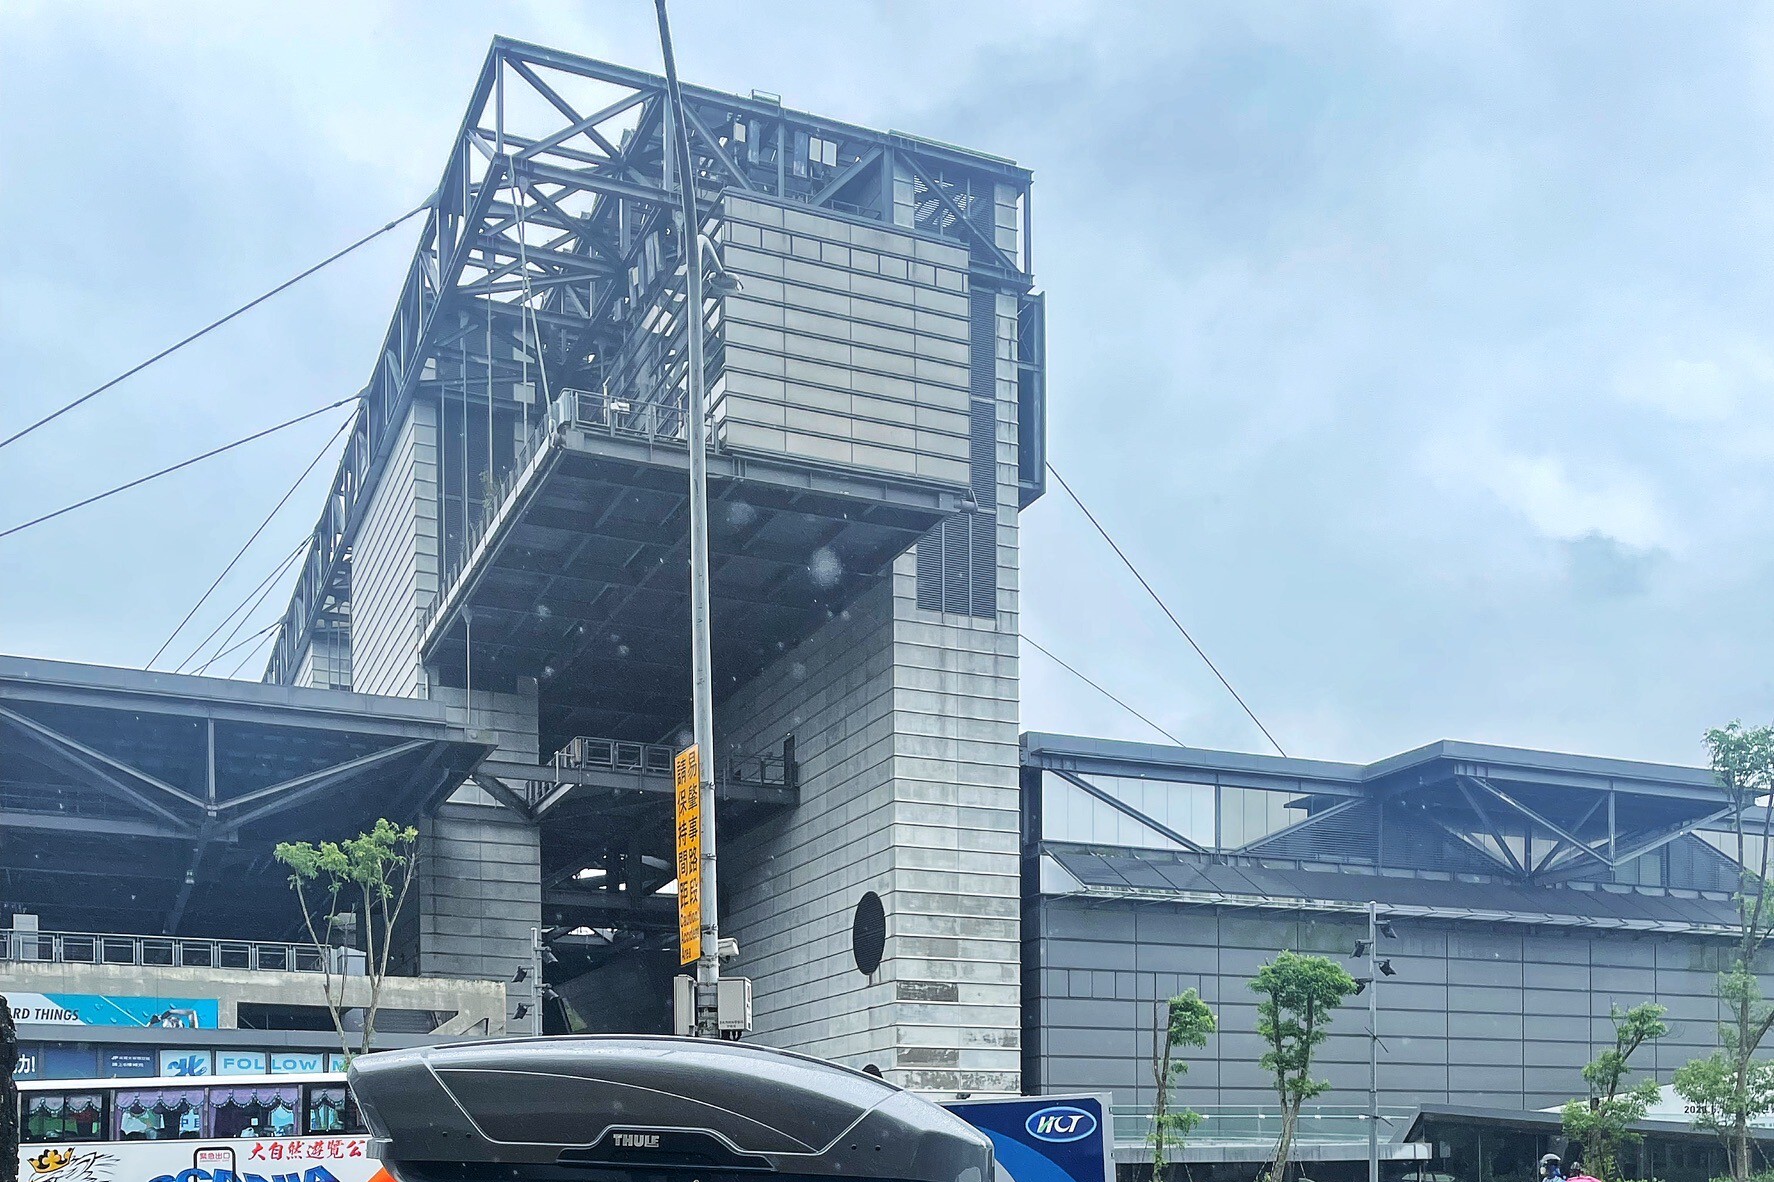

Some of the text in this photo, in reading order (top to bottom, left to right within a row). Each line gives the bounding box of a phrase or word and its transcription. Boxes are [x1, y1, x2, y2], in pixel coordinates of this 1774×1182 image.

[676, 757, 688, 909] 請保持間距
[687, 750, 698, 905] 易肇事路段
[11, 1007, 80, 1021] RD THINGS
[223, 1057, 318, 1071] FOLLOW
[612, 1133, 660, 1148] THULE
